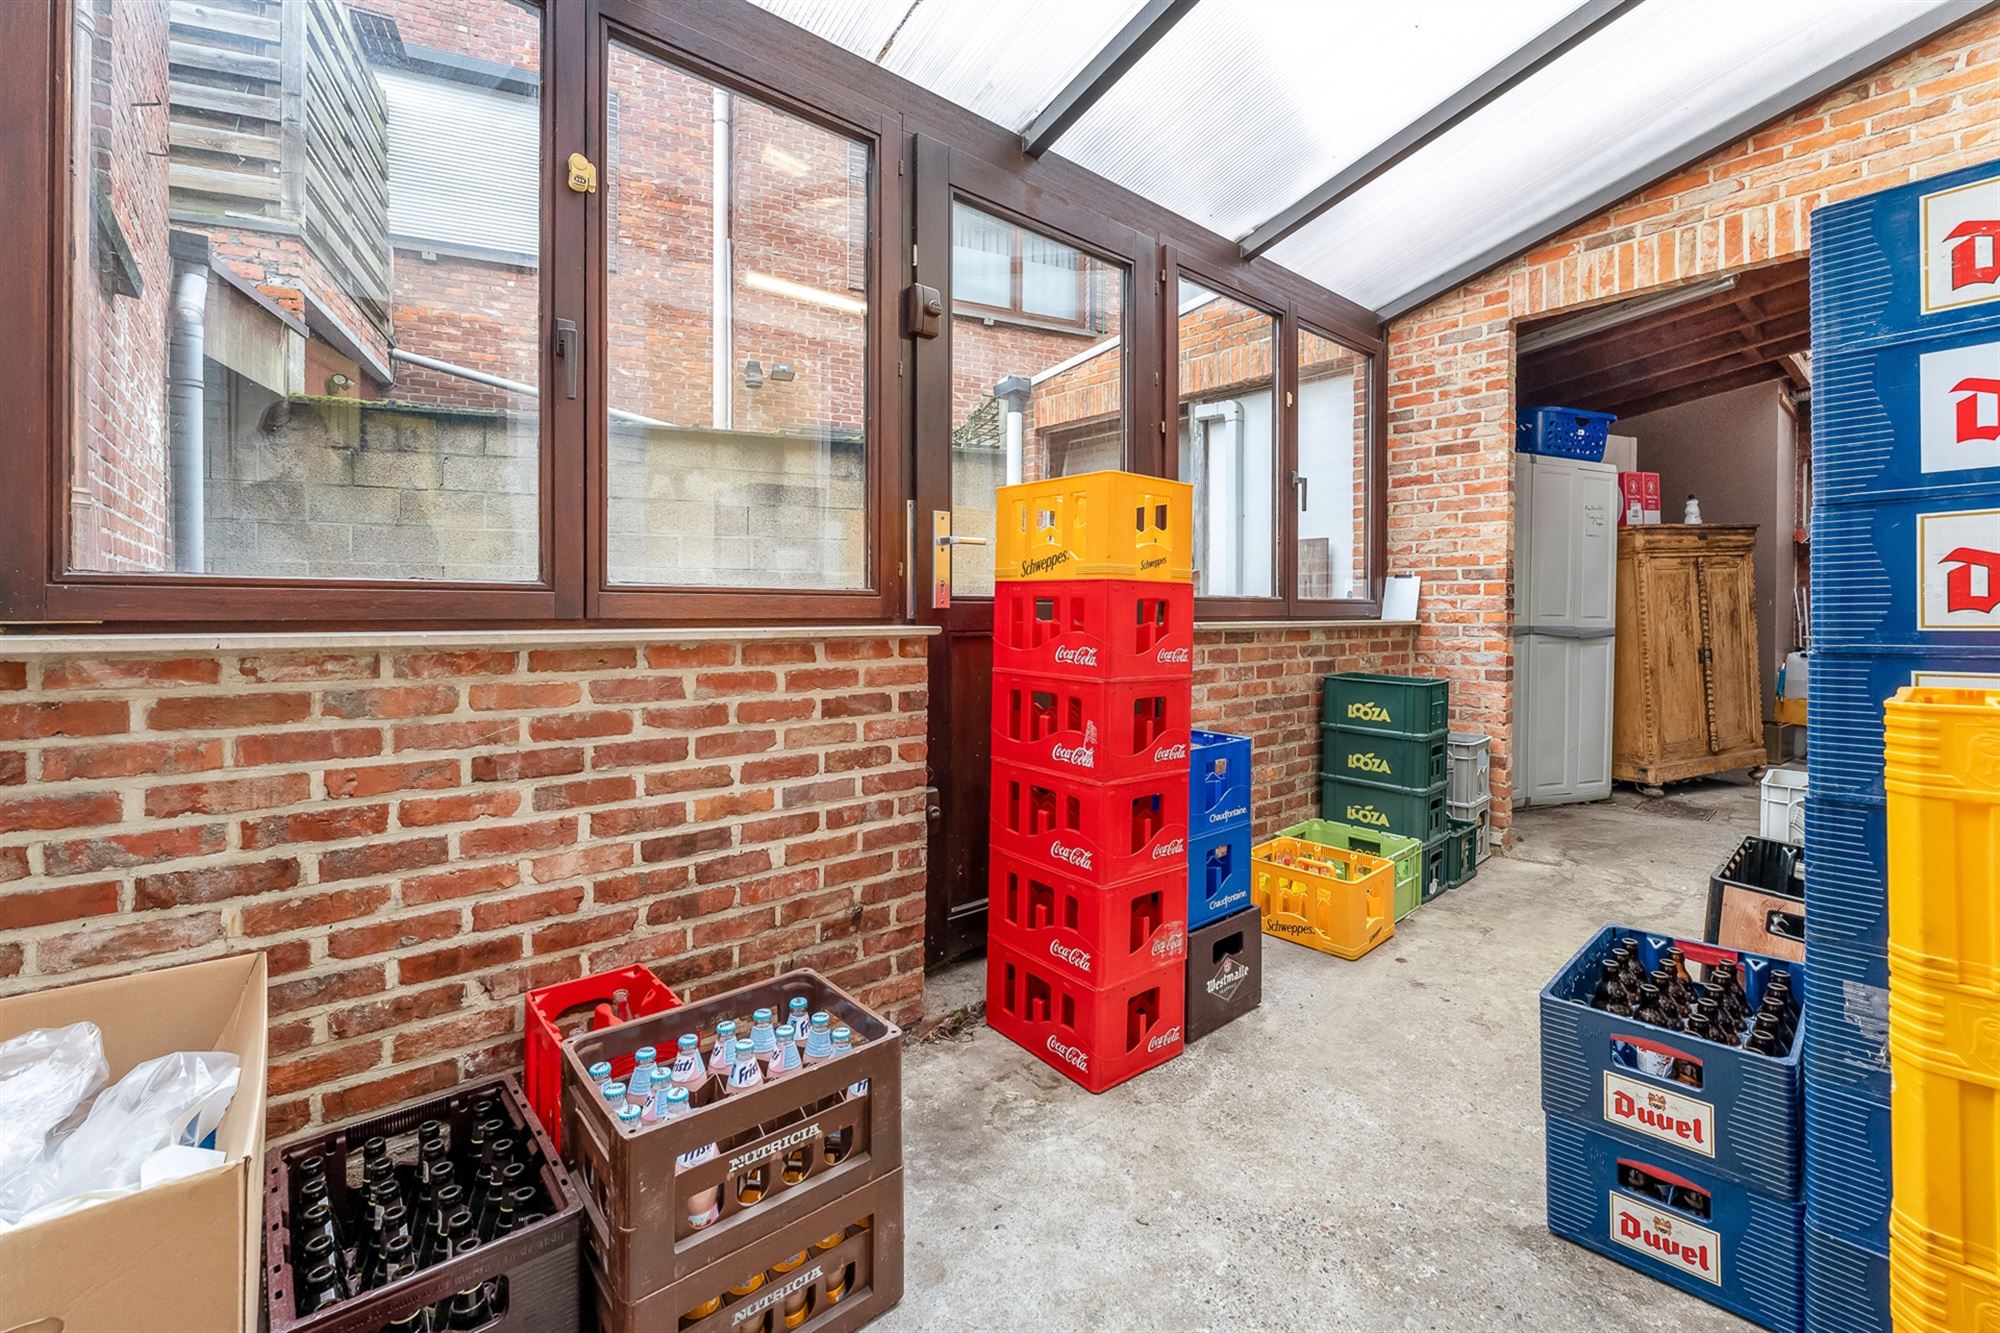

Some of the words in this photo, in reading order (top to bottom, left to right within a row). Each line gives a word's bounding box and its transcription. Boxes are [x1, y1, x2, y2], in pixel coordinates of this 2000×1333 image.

[1055, 645, 1097, 666] Coca-Cola
[1157, 648, 1189, 663] Coca-Cola
[1347, 702, 1391, 722] LOOZA
[1052, 742, 1095, 768] Coca-Cola
[1154, 744, 1186, 762] Coca-Cola
[1347, 753, 1391, 774] LOOZA
[1209, 806, 1247, 823] Chaudfontaine
[1051, 840, 1093, 871] Coca-Cola
[1152, 838, 1184, 860] Coca-Cola
[1209, 889, 1247, 910] Chaudfontaine
[1049, 938, 1091, 972] Coca-Cola
[1206, 965, 1249, 993] Westmalle
[1147, 1025, 1181, 1053] Coca-Cola
[1047, 1034, 1089, 1074] Coca-Cola
[1613, 1090, 1704, 1144] Duvel
[728, 1123, 822, 1172] NUTRICIA
[1619, 1211, 1710, 1271] Duvel
[731, 1265, 824, 1327] NUTRICIA
